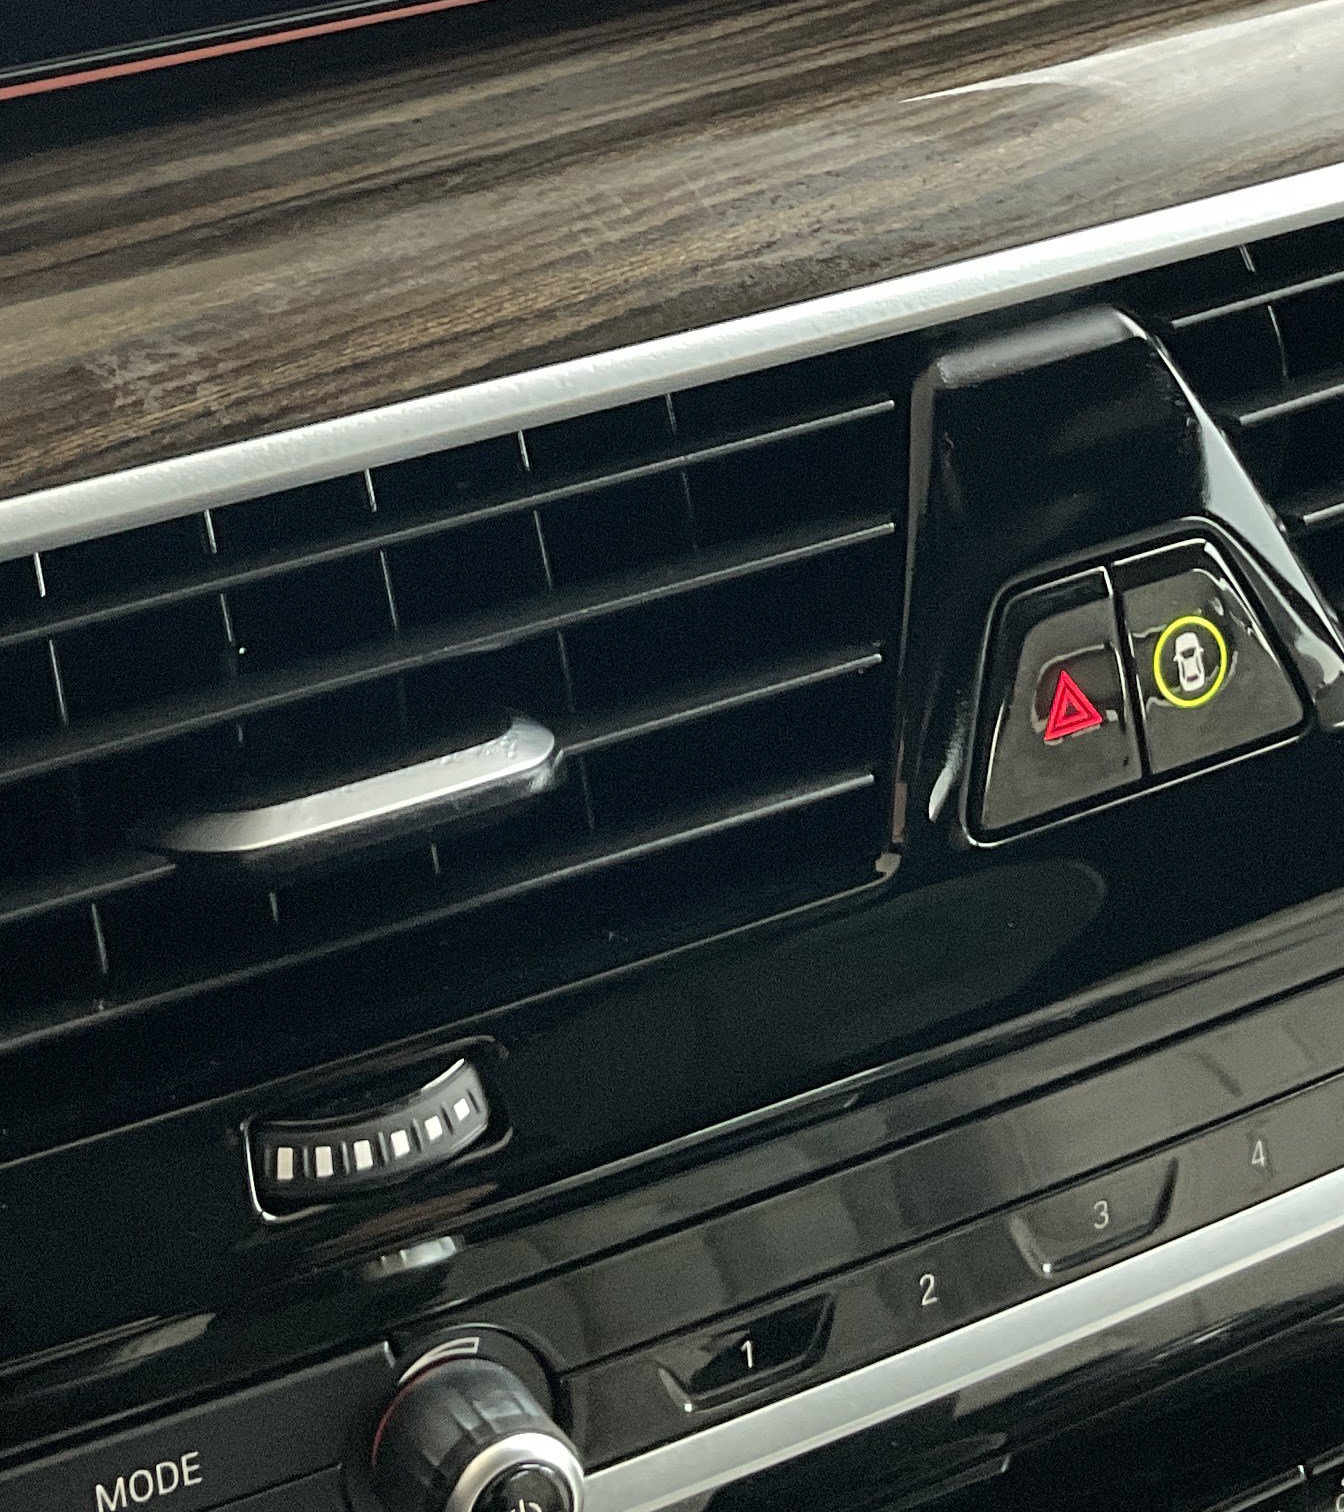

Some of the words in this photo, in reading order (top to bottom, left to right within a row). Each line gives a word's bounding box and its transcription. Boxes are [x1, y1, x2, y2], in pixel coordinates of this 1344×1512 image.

[1250, 1139, 1267, 1169] 4
[1092, 1199, 1111, 1229] 3
[918, 1272, 940, 1306] 2
[739, 1338, 755, 1369] 1
[94, 1450, 204, 1512] MODE
